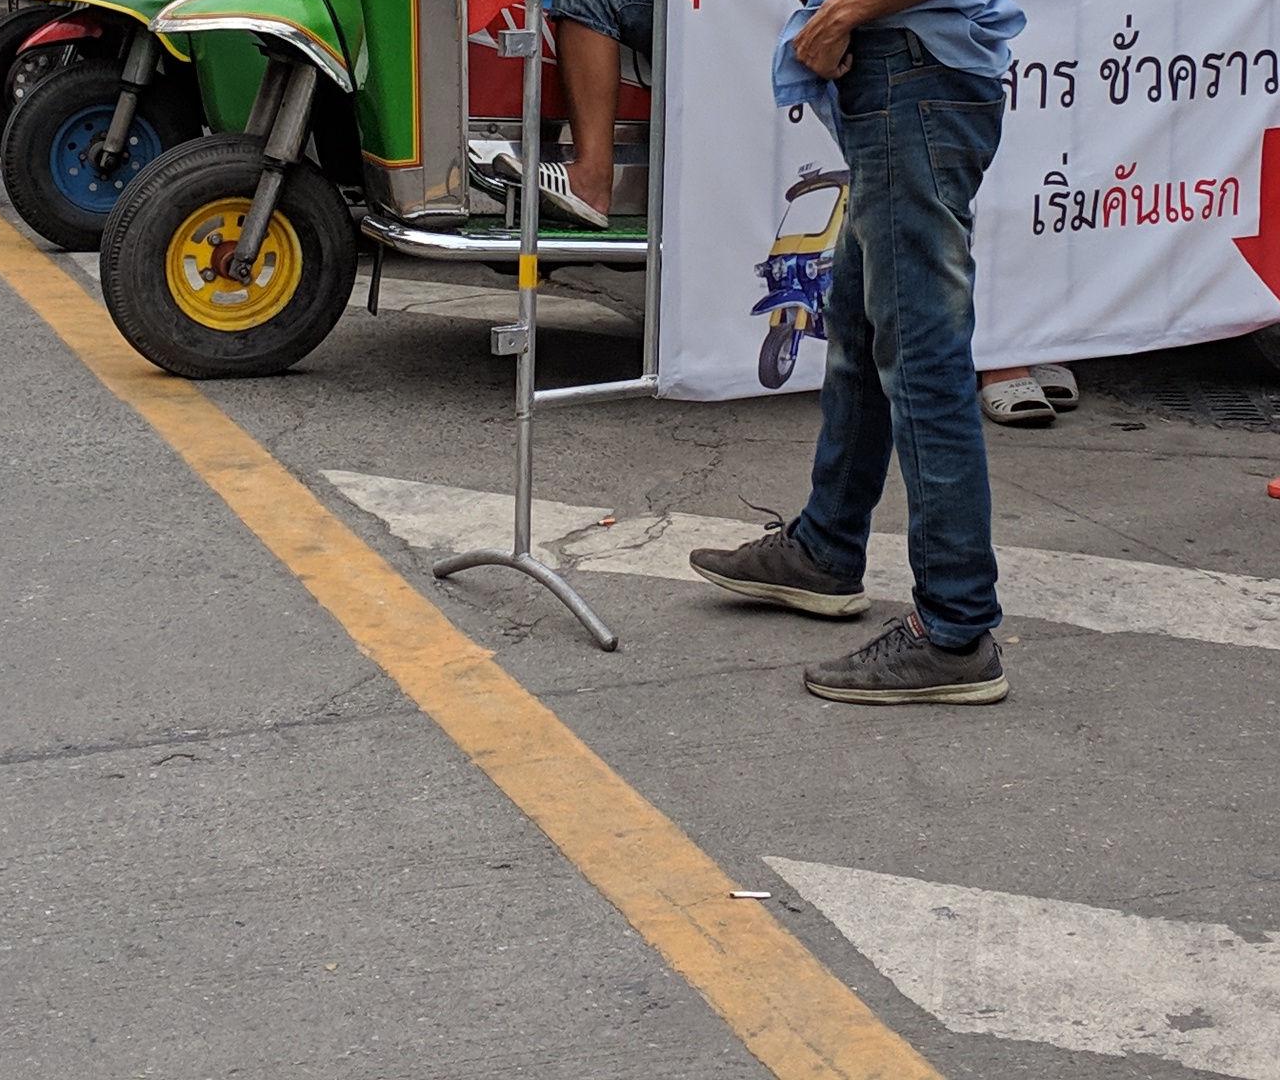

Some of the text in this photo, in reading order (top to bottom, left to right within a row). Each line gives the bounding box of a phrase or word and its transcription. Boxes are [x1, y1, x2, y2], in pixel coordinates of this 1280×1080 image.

[1099, 14, 1279, 105] ชั่วคราว
[1032, 152, 1240, 236] เริ่มคันแรก
